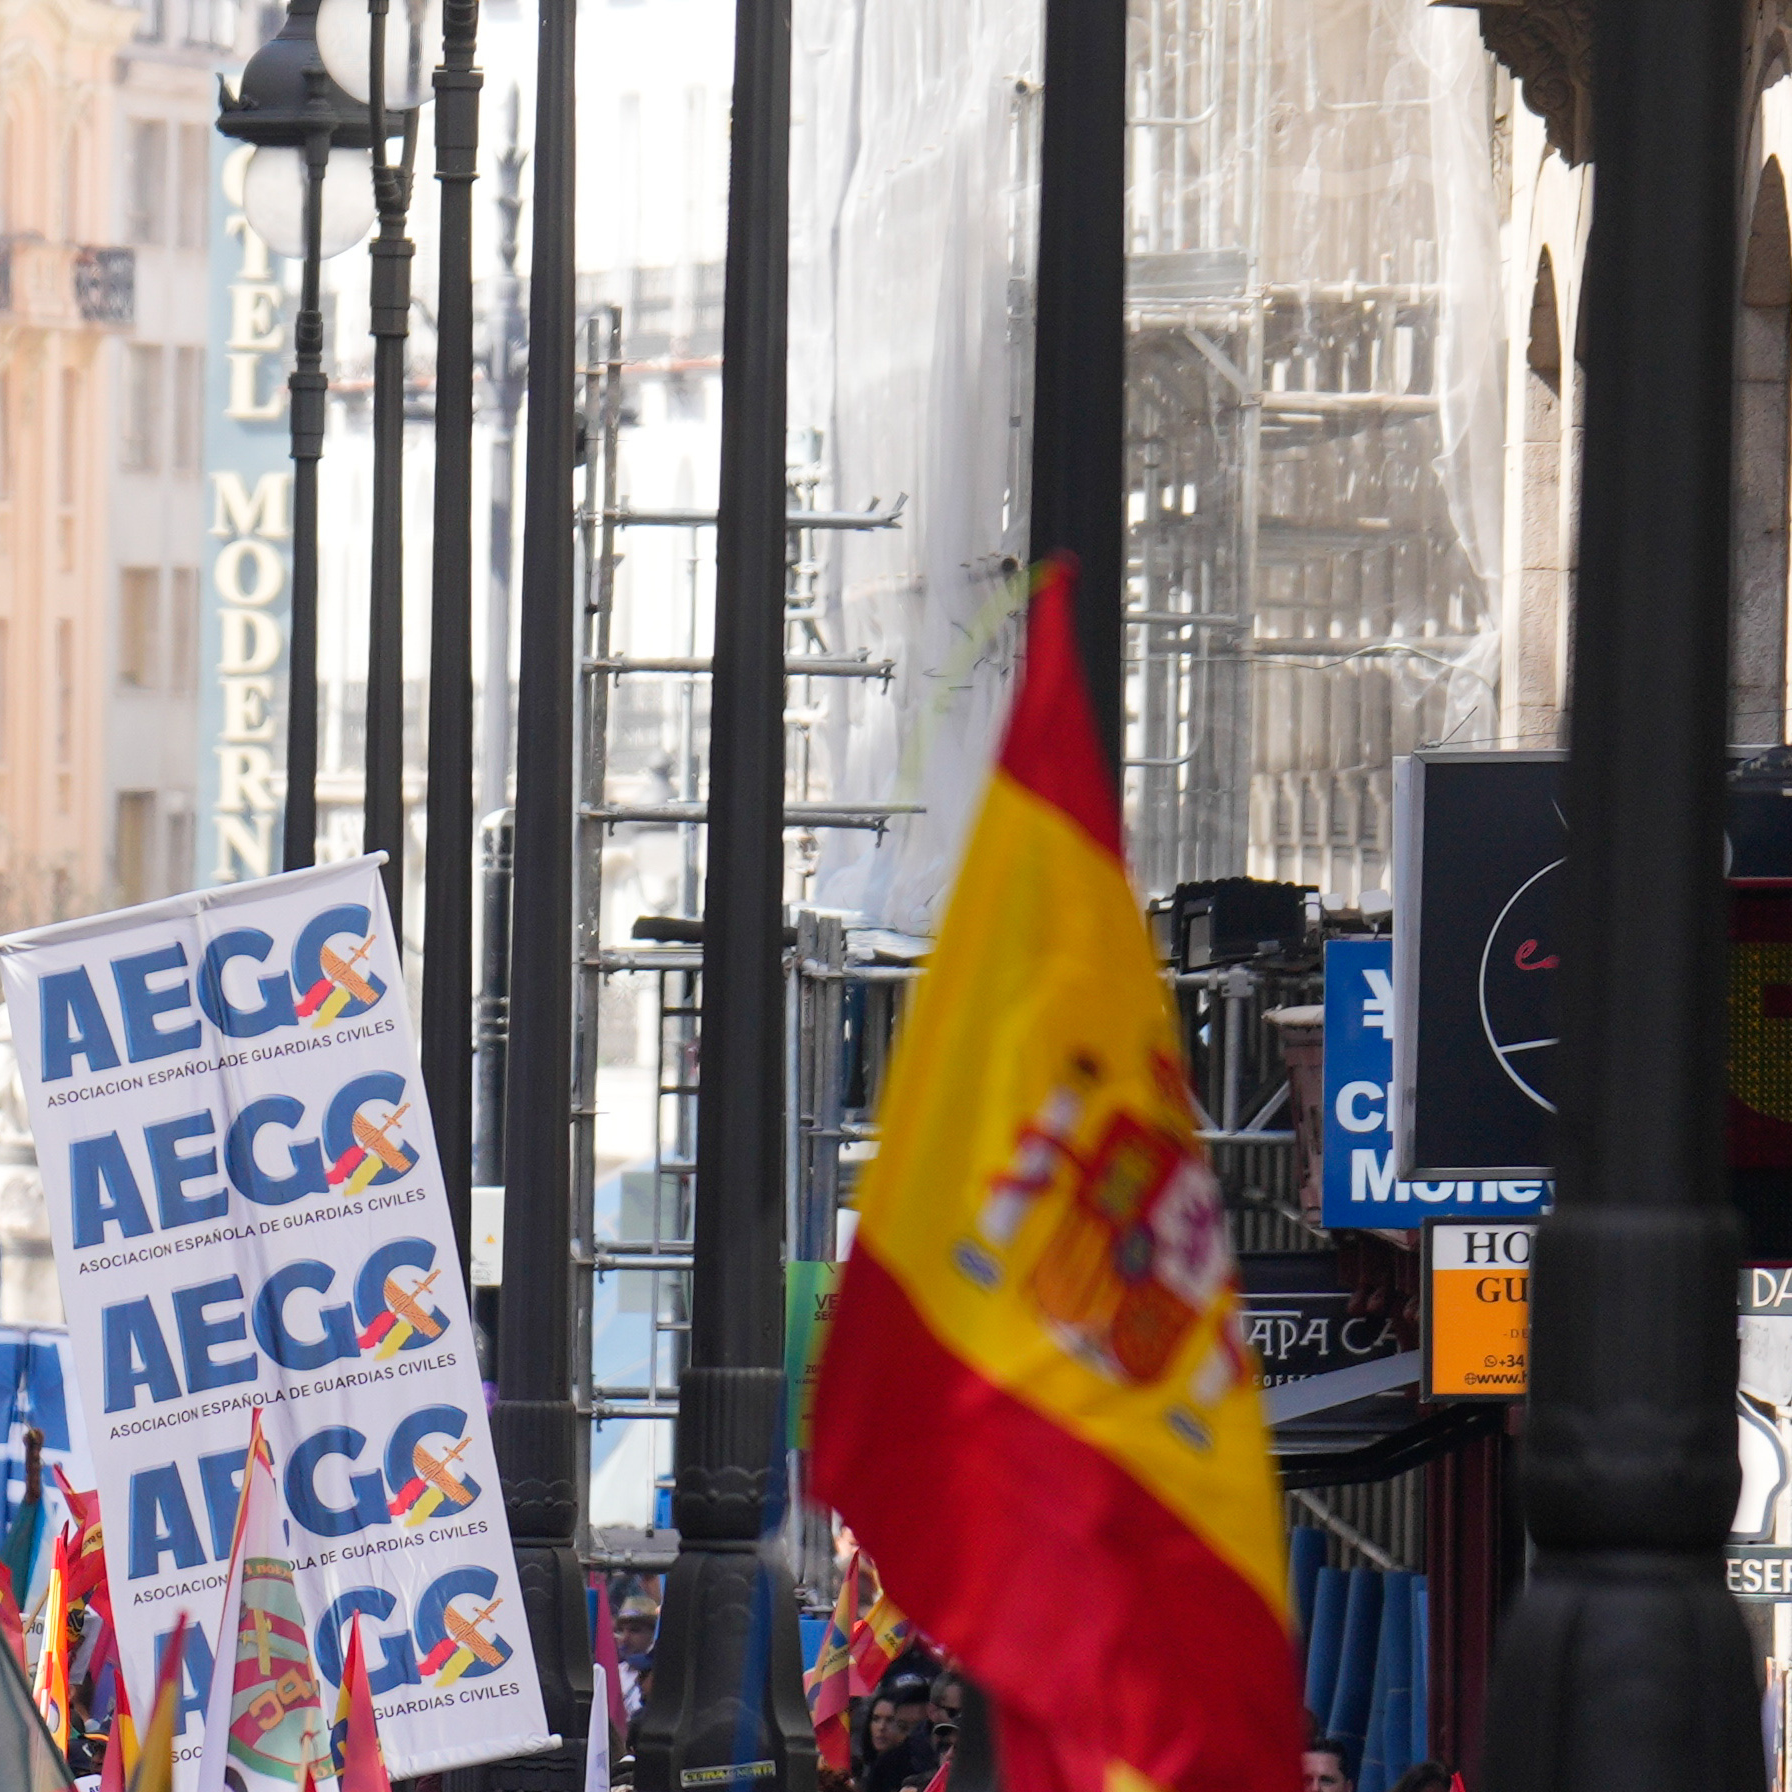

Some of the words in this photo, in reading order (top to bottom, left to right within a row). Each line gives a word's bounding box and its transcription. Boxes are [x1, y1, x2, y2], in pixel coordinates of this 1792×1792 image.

[207, 470, 293, 878] MODERN
[38, 903, 388, 1083] AEGC
[47, 1076, 144, 1109] ASOCIACION
[147, 1058, 225, 1087] ESPAÑOLA
[225, 1052, 249, 1068] DE
[251, 1035, 332, 1063] GUARDIAS
[335, 1018, 396, 1045] CIVILES
[69, 1070, 420, 1250] AEGC
[79, 1244, 173, 1276] ASOCIACION
[174, 1225, 257, 1253] ESPAÑOLA
[260, 1218, 281, 1234] DE
[283, 1201, 363, 1231] GUARDIAS
[367, 1188, 426, 1213] CIVILES
[101, 1236, 451, 1414] AEGC
[109, 1408, 199, 1440] ASOCIACION
[202, 1387, 286, 1418] ESPAÑOLA
[289, 1383, 311, 1400] DE
[314, 1367, 394, 1394] GUARDIAS
[398, 1353, 457, 1379] CIVILES
[132, 1573, 229, 1606] ASOCIACION
[319, 1549, 339, 1566] DE
[342, 1533, 425, 1561] GUARDIAS
[429, 1520, 489, 1544] CIVILES
[460, 1682, 520, 1706] CIVILES
